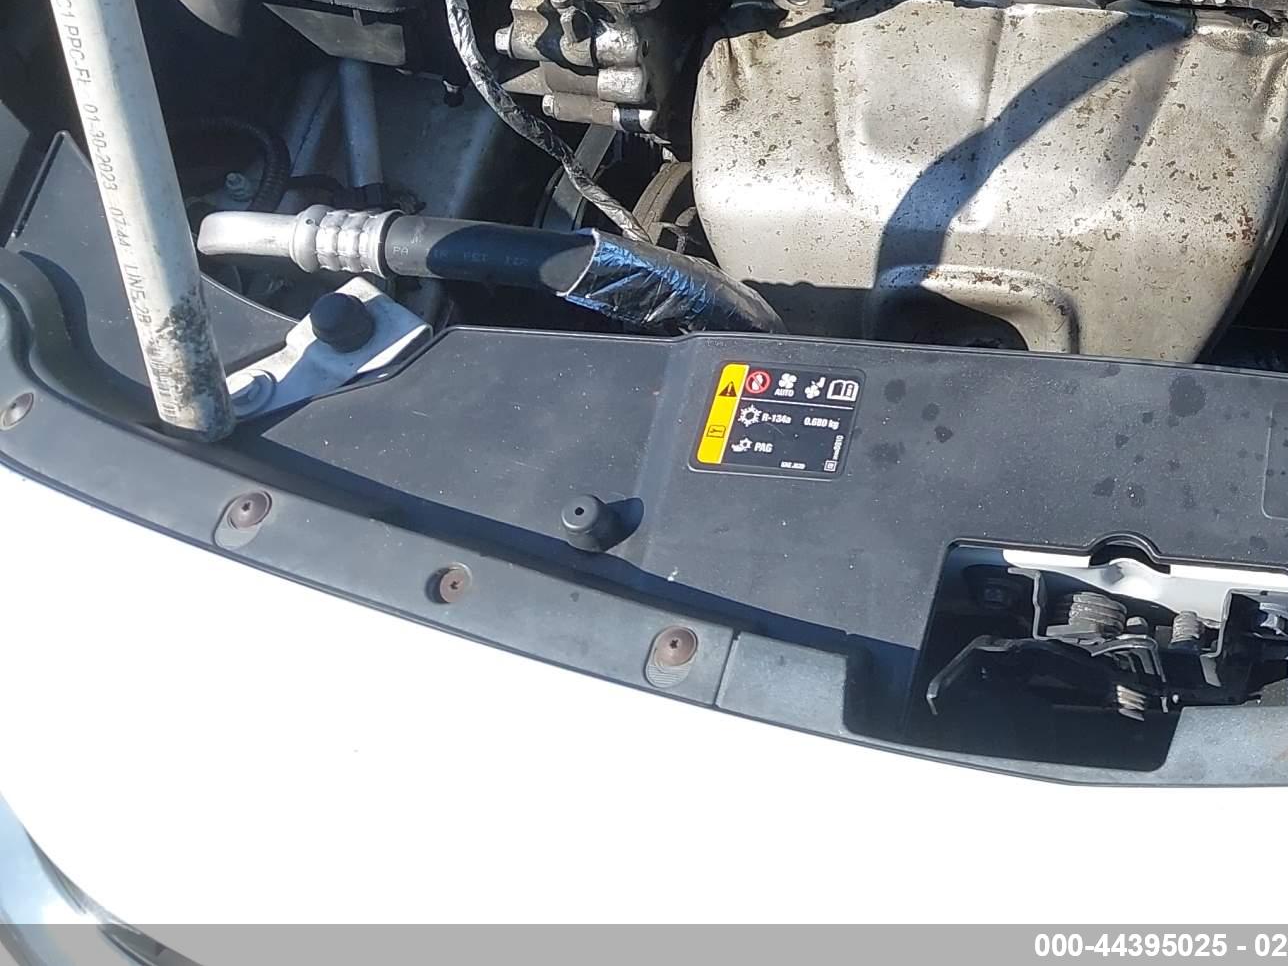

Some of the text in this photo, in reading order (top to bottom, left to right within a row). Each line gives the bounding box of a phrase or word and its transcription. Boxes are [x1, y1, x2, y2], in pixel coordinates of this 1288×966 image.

[774, 388, 795, 398] AUTO
[761, 413, 792, 424] R-134a
[828, 419, 840, 430] kg
[753, 441, 774, 453] PAG
